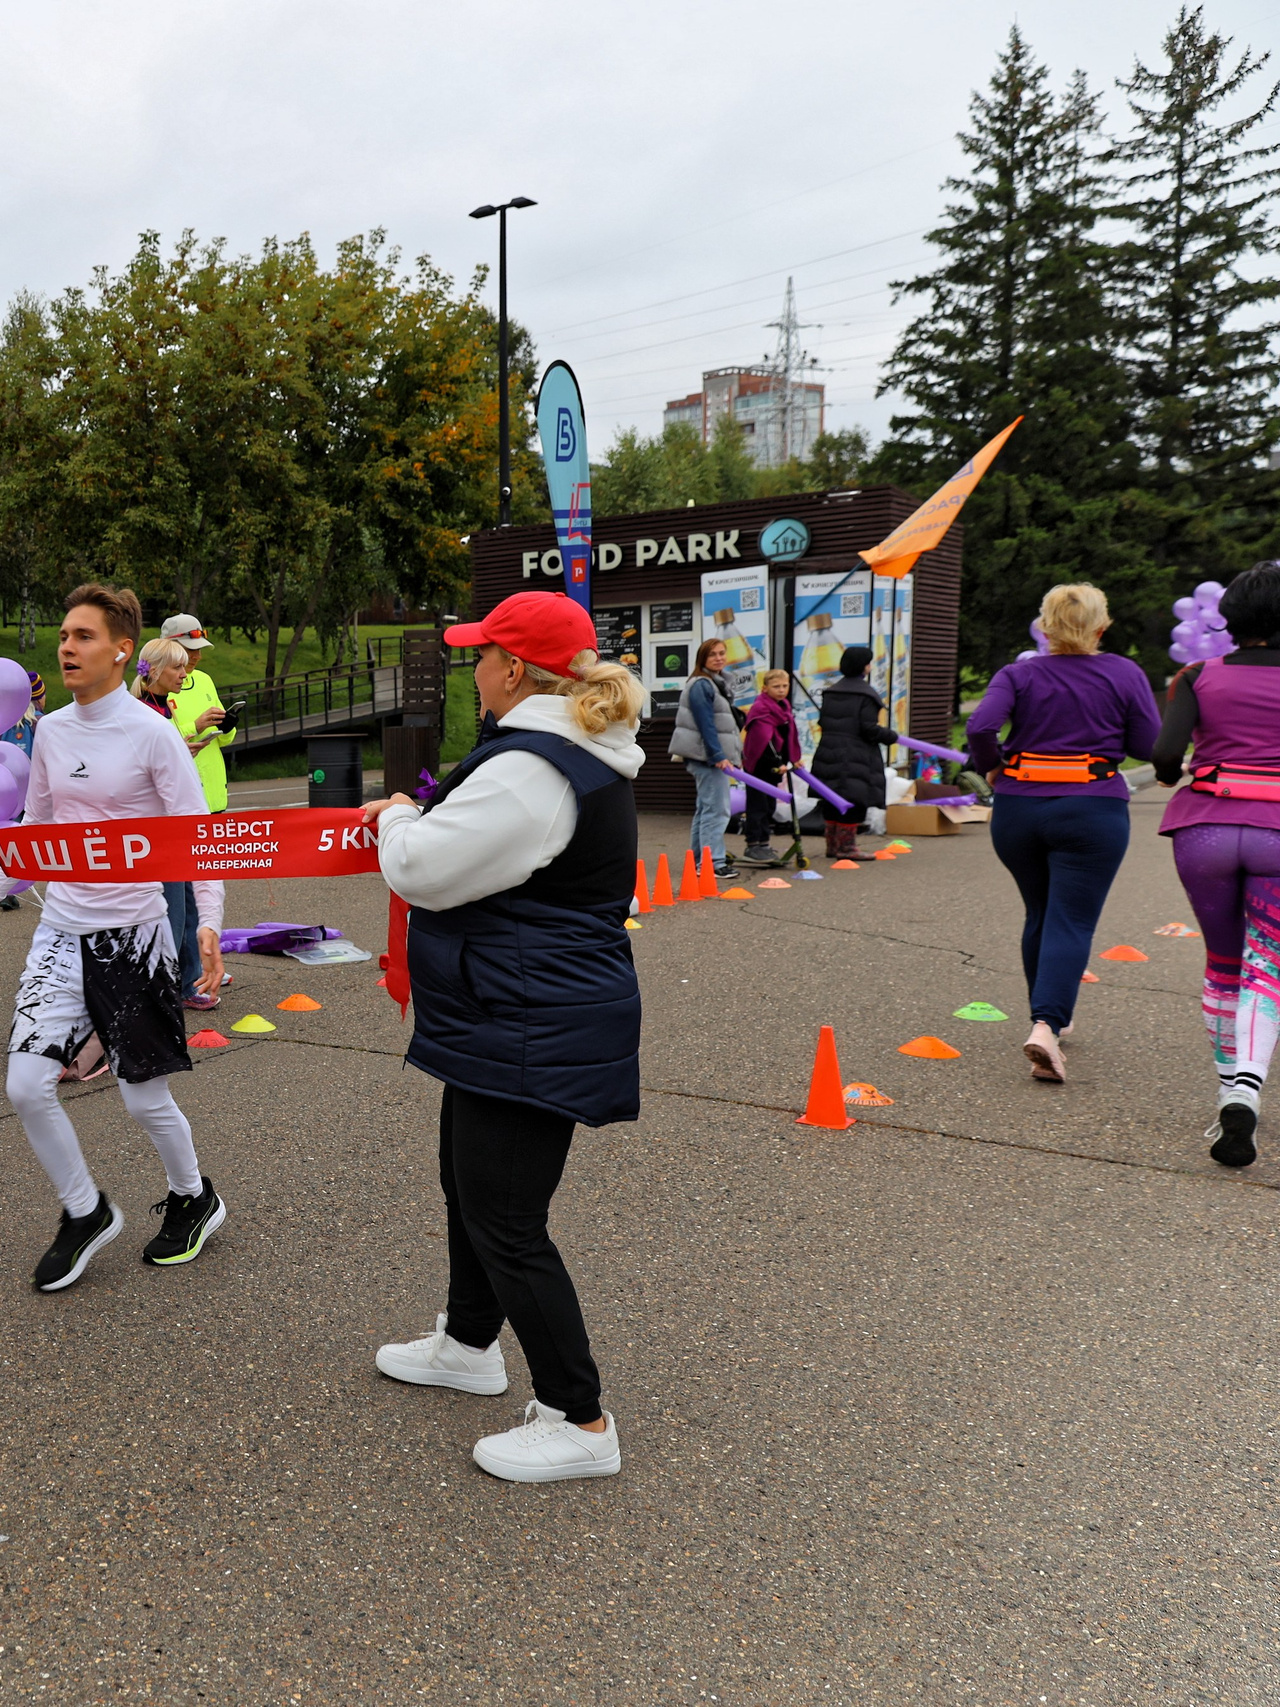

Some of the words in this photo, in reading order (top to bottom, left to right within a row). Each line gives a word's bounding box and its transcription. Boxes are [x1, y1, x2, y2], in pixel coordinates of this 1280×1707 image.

[522, 543, 623, 578] FOD
[635, 529, 742, 567] PARK
[197, 824, 207, 839] 5
[213, 819, 274, 838] ВЁРСТ
[191, 841, 279, 856] КРАСНОЯРСК
[318, 829, 335, 851] 5
[197, 858, 272, 870] НАБЕРЕЖНАЯ
